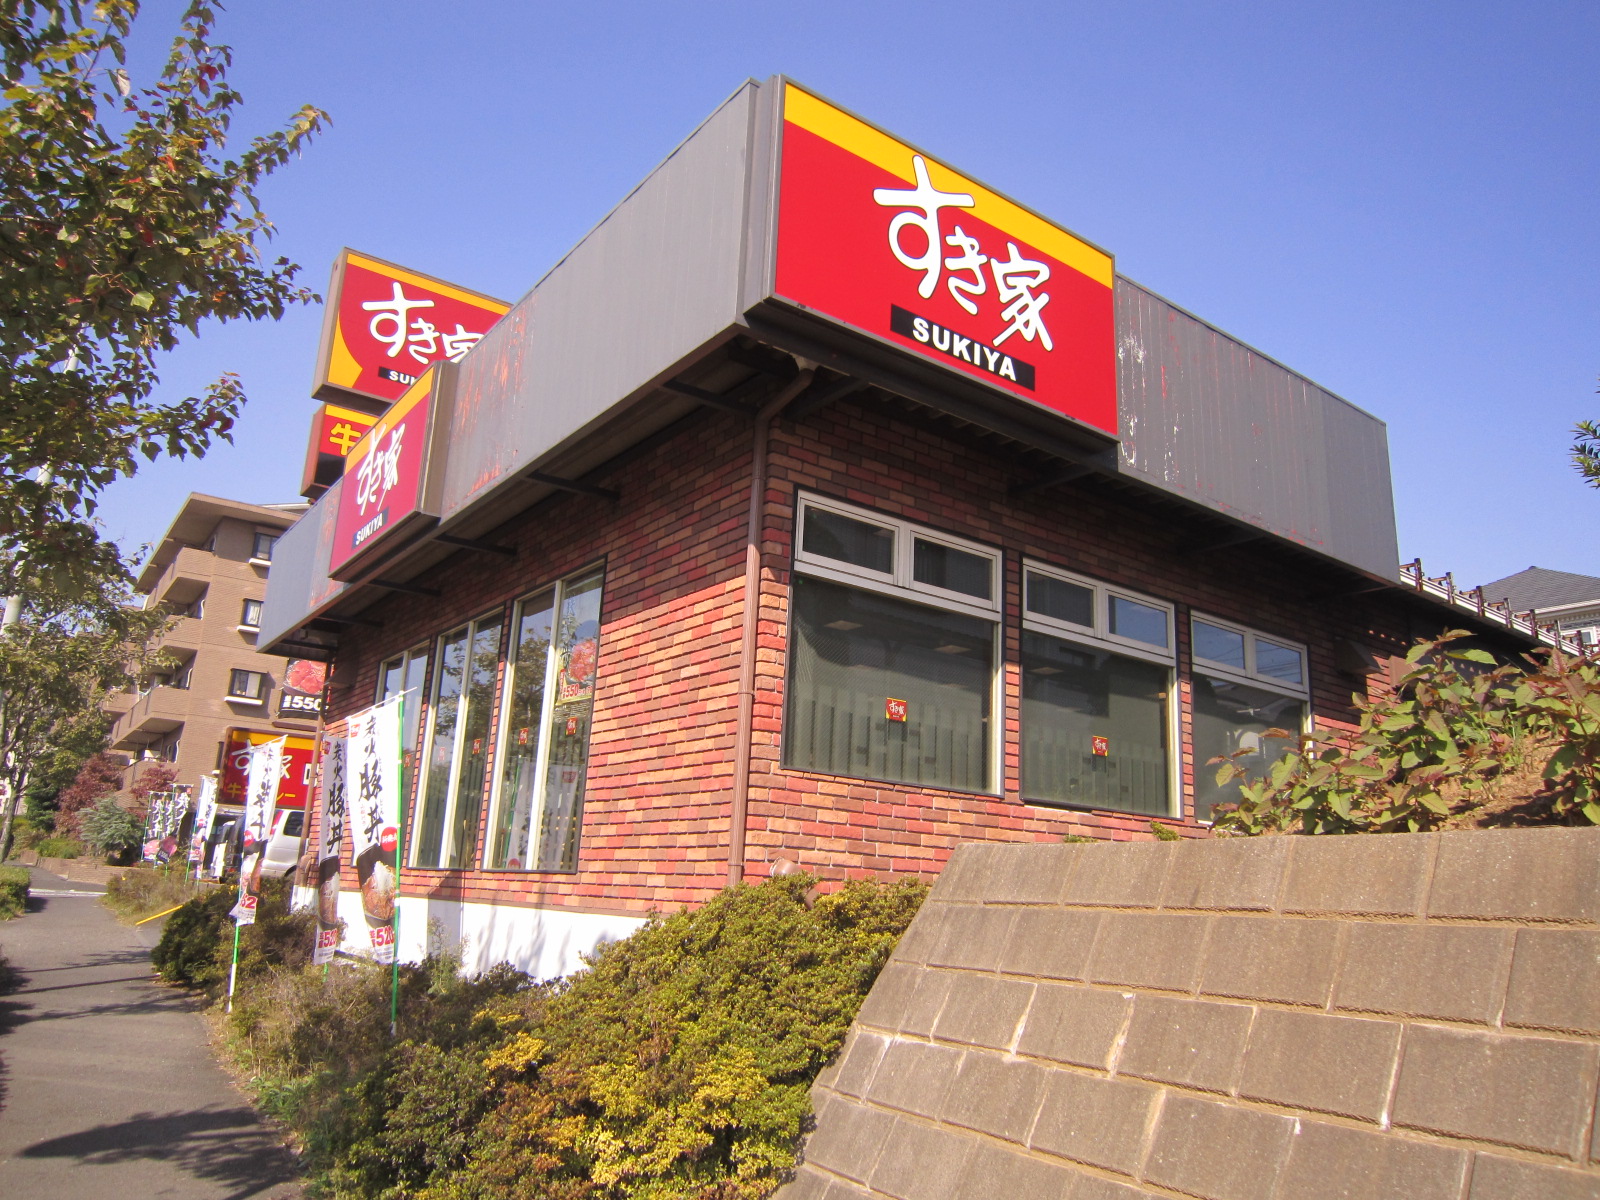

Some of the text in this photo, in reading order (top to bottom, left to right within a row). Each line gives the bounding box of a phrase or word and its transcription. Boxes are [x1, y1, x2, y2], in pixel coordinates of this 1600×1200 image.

[873, 154, 1053, 352] すき家
[912, 316, 1017, 382] SUKIYA
[356, 423, 406, 517] すき家
[355, 512, 383, 546] SUKIYA
[326, 740, 346, 855] 炭火豚丼
